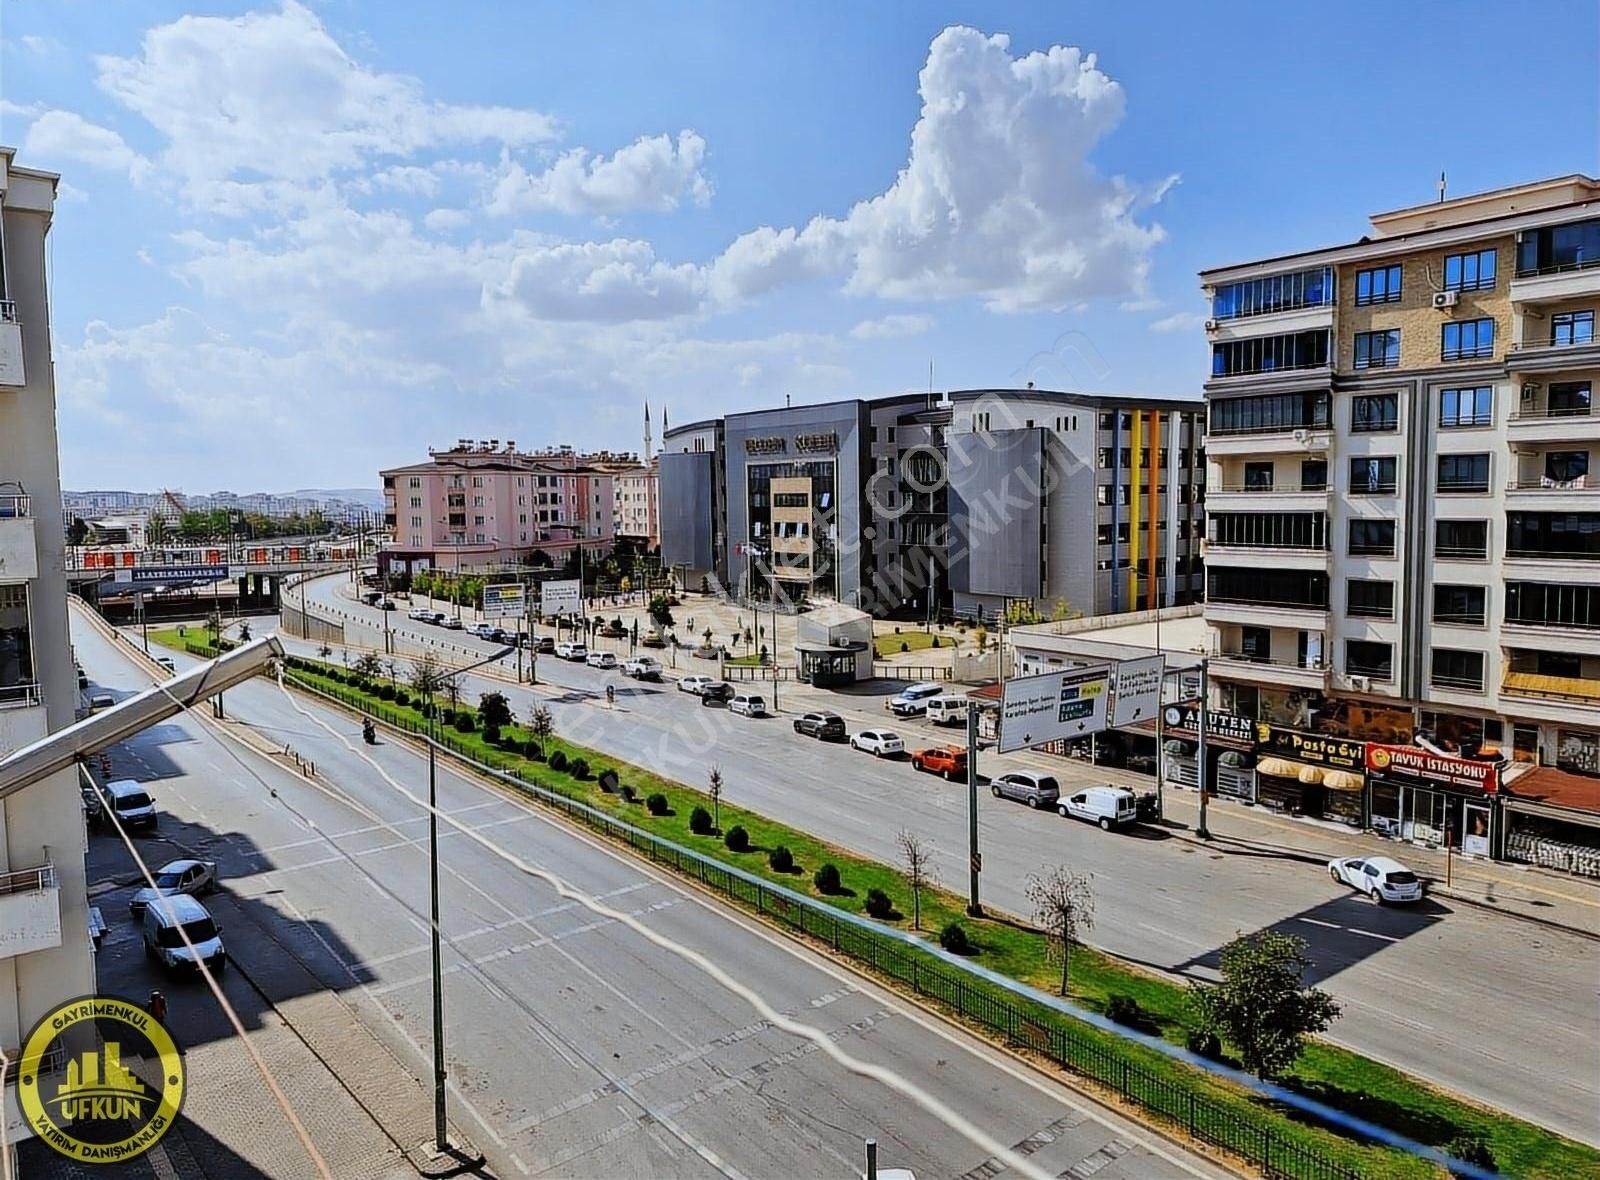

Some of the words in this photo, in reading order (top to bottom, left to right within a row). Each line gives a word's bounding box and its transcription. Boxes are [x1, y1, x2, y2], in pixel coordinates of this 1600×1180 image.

[1184, 710, 1251, 730] AUTEN
[1292, 734, 1336, 754] Pasta
[1338, 743, 1362, 759] Evi
